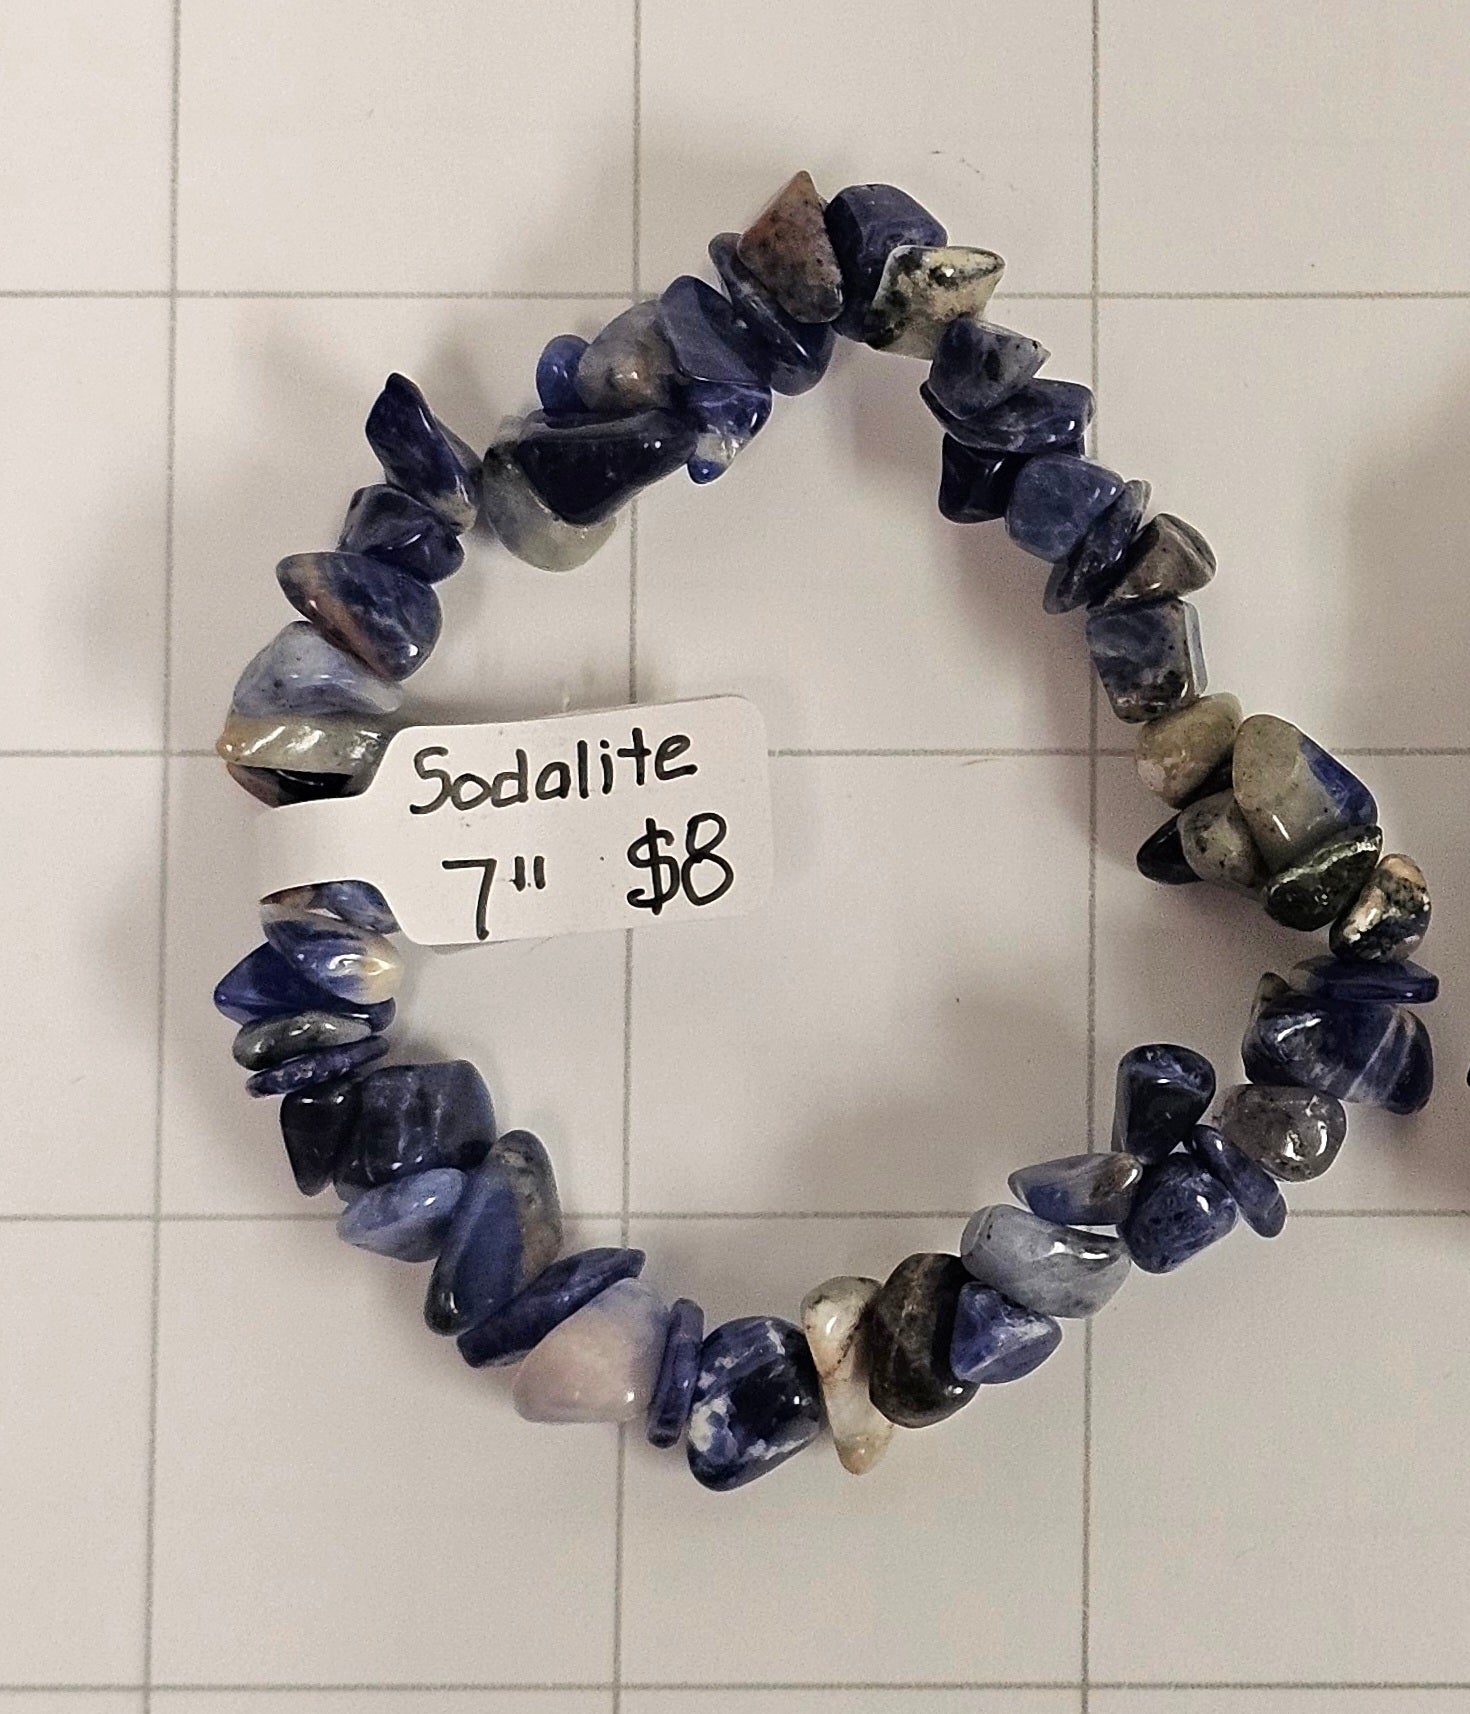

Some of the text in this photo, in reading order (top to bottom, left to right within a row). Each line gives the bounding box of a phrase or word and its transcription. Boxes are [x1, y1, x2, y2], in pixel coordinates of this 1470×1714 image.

[408, 726, 699, 816] Sodalite
[441, 811, 735, 941] 7" $8
